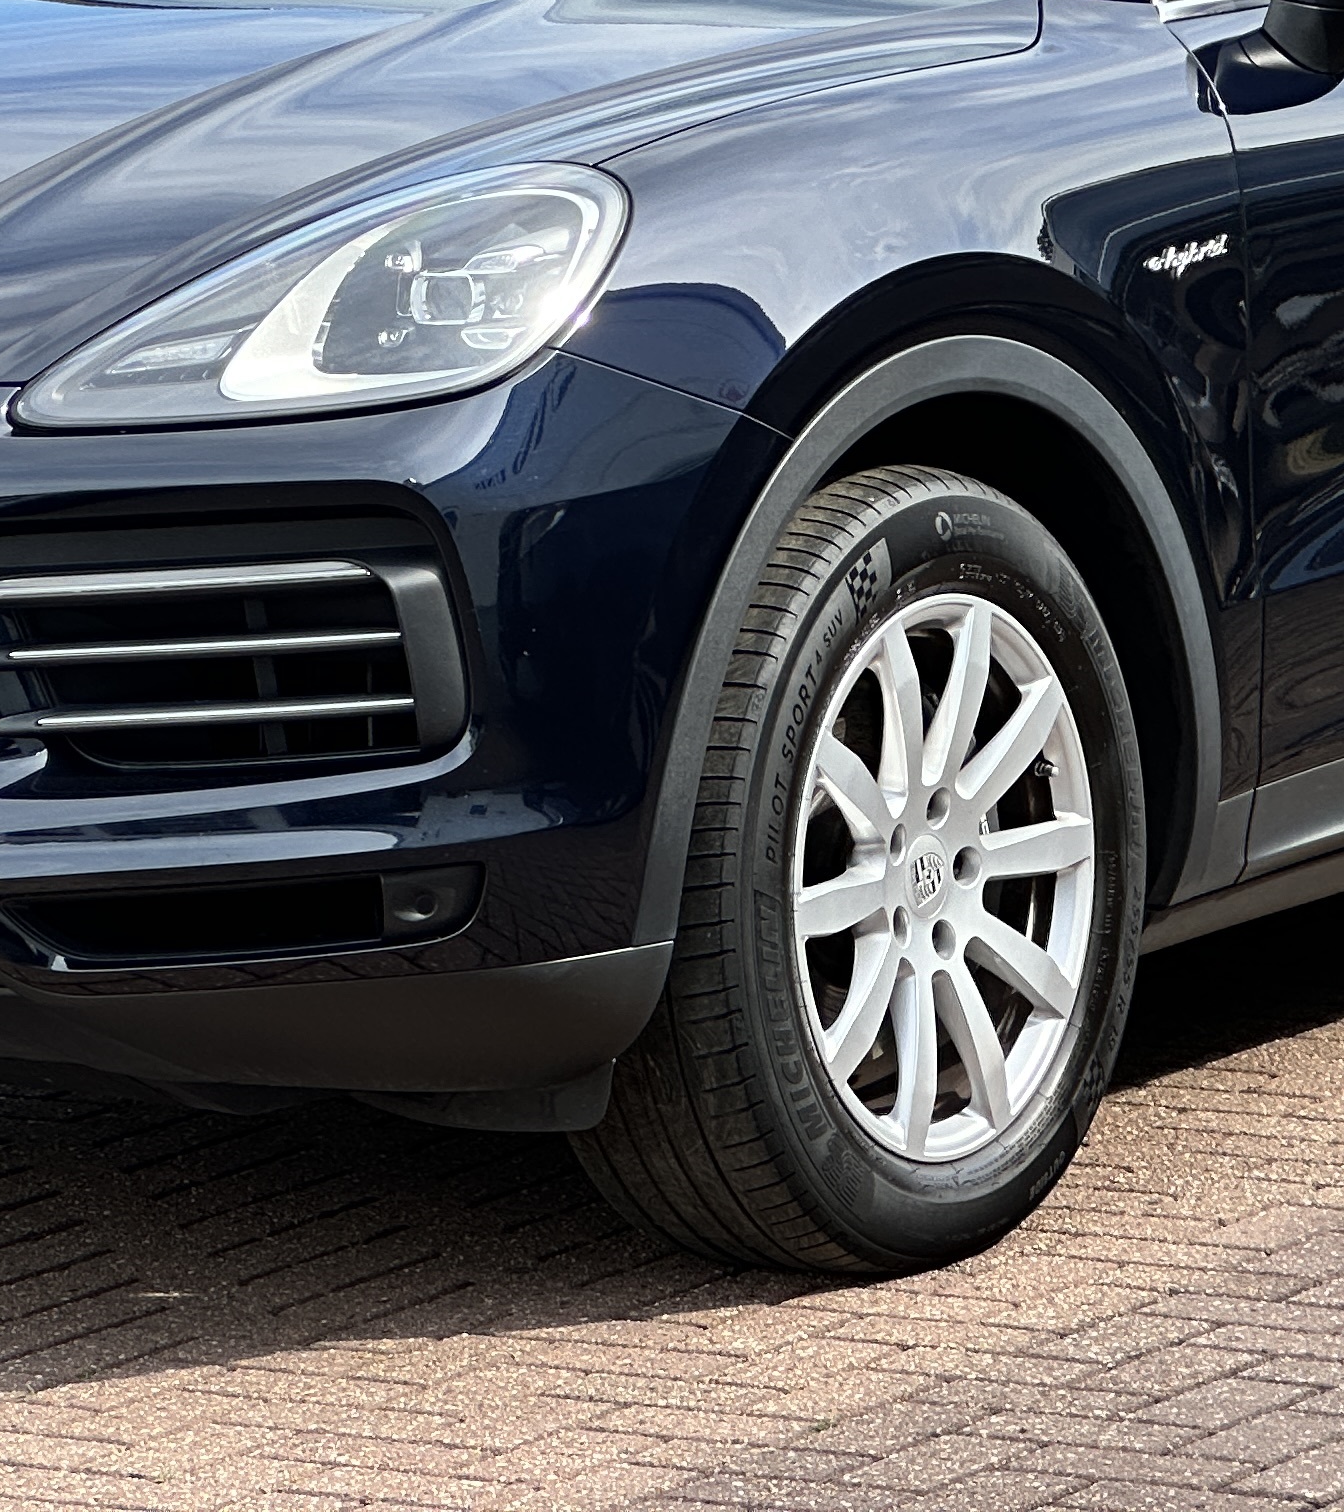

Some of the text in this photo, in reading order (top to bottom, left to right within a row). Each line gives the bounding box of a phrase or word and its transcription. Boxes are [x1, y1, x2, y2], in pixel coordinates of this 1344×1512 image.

[764, 772, 788, 865] PILOT
[781, 662, 818, 764] SPORT
[822, 609, 843, 649] SUV
[758, 902, 829, 1141] MICHELIN
